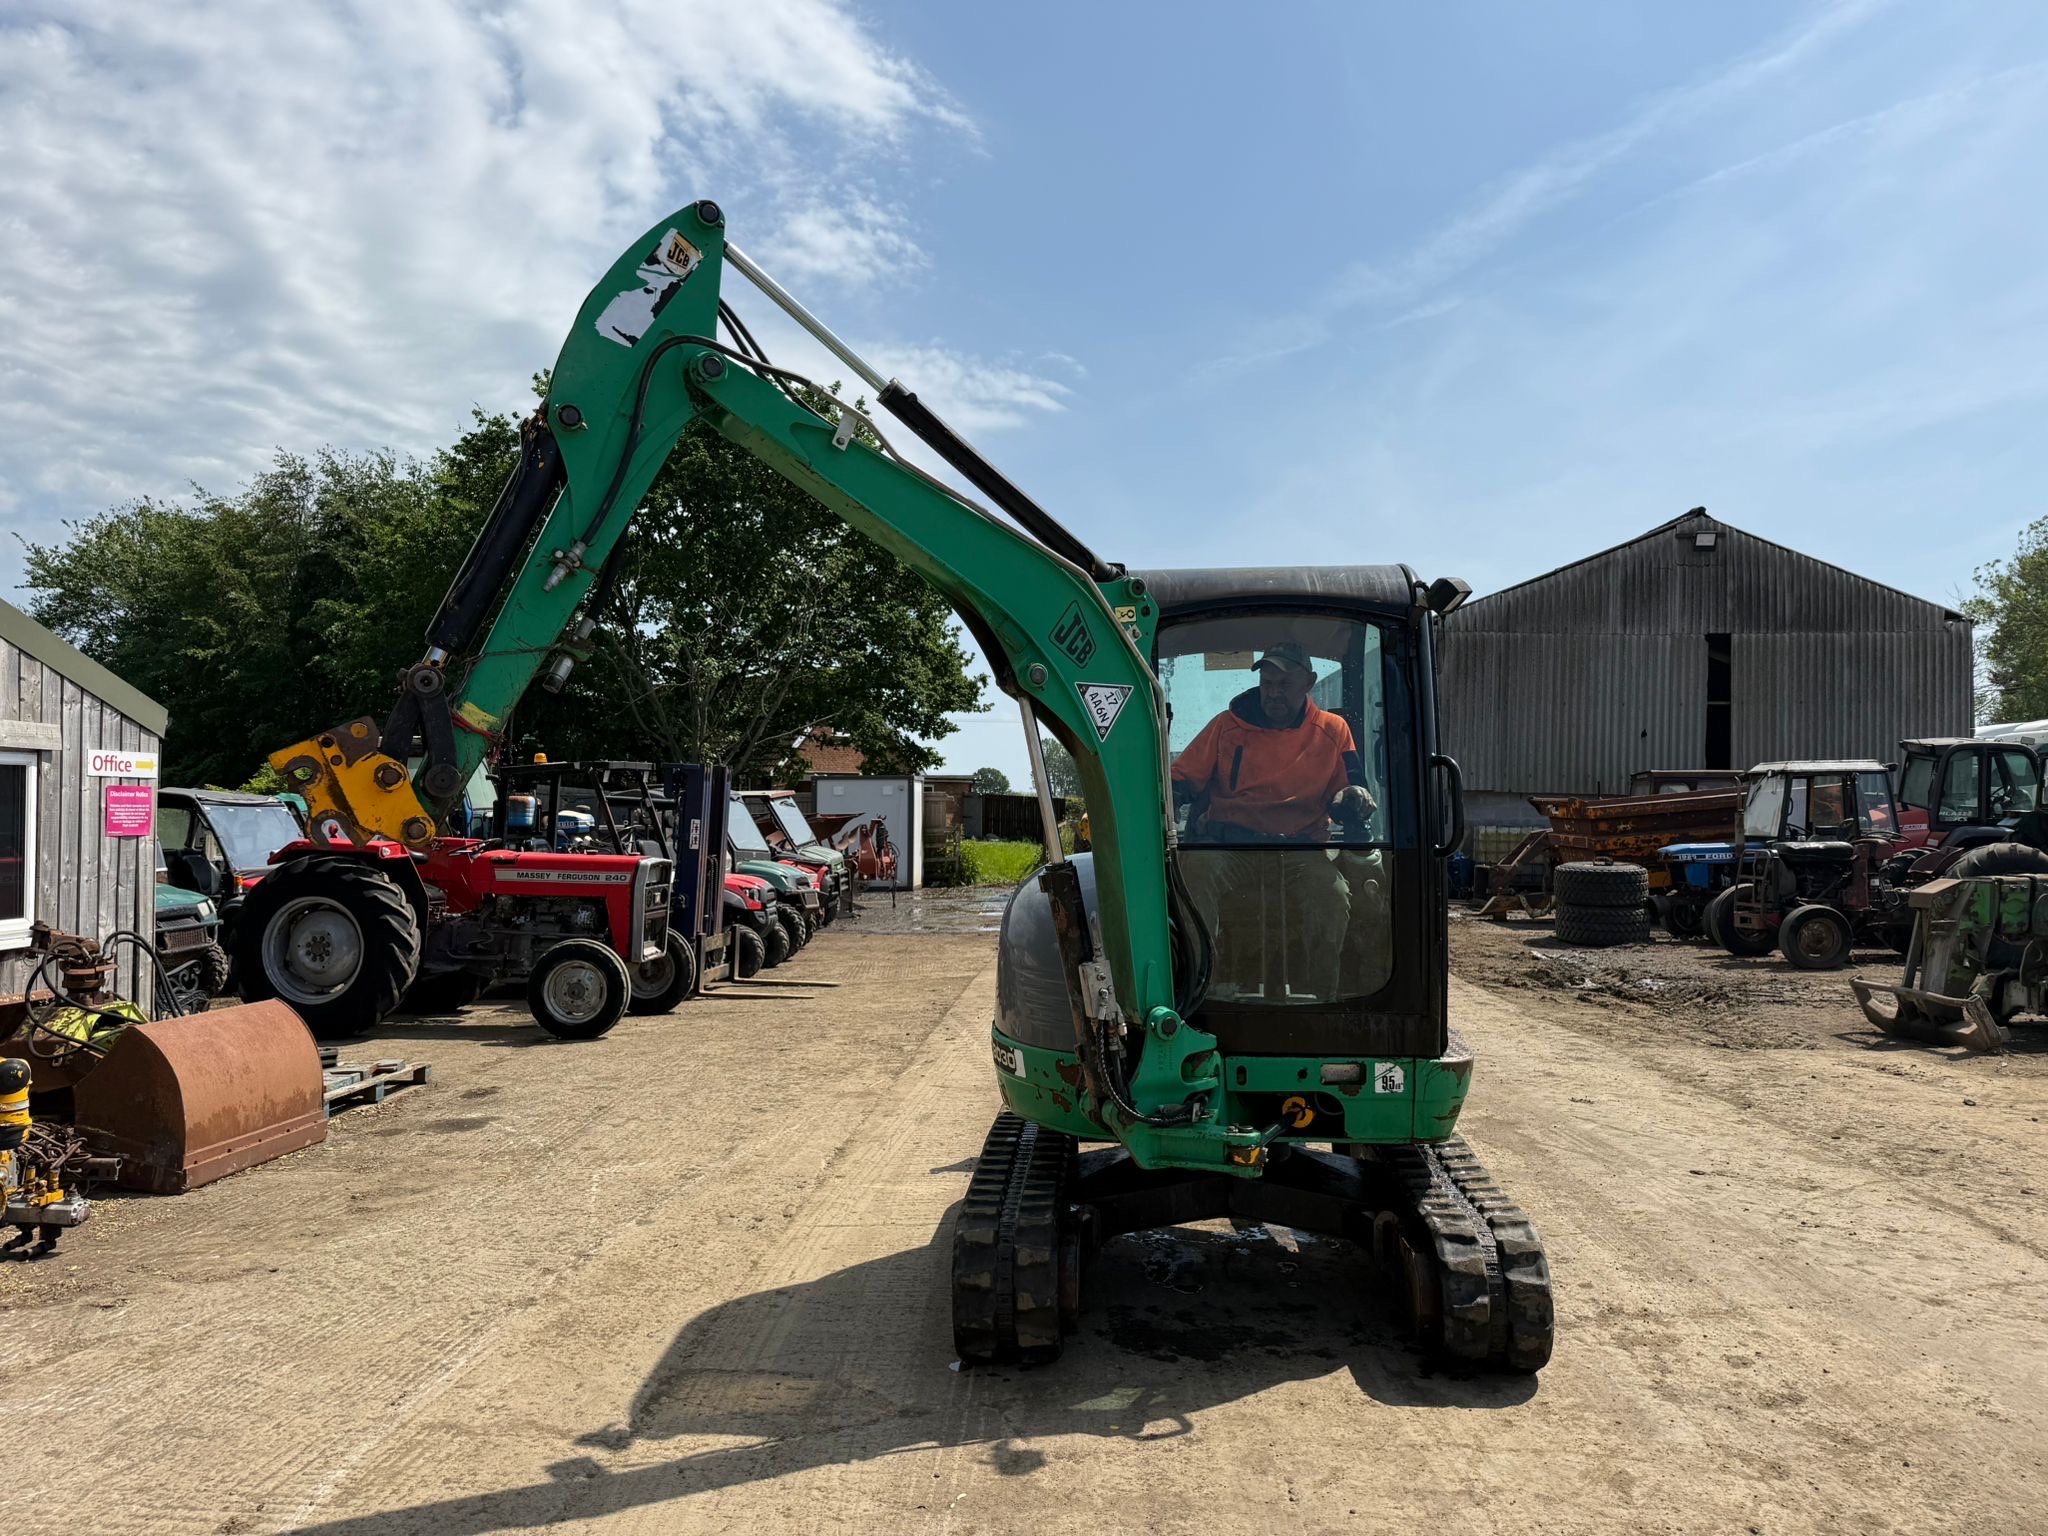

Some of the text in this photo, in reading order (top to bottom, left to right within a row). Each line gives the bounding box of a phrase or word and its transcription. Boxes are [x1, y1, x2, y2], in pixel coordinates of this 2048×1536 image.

[667, 242, 690, 267] JCB
[1054, 612, 1093, 664] JCB
[1104, 691, 1119, 706] 17
[1089, 692, 1110, 723] AA6N
[92, 754, 132, 772] Office
[1705, 852, 1733, 860] FORD
[516, 871, 627, 882] MASSEY FERGUSON 240
[1381, 1075, 1396, 1090] 95
